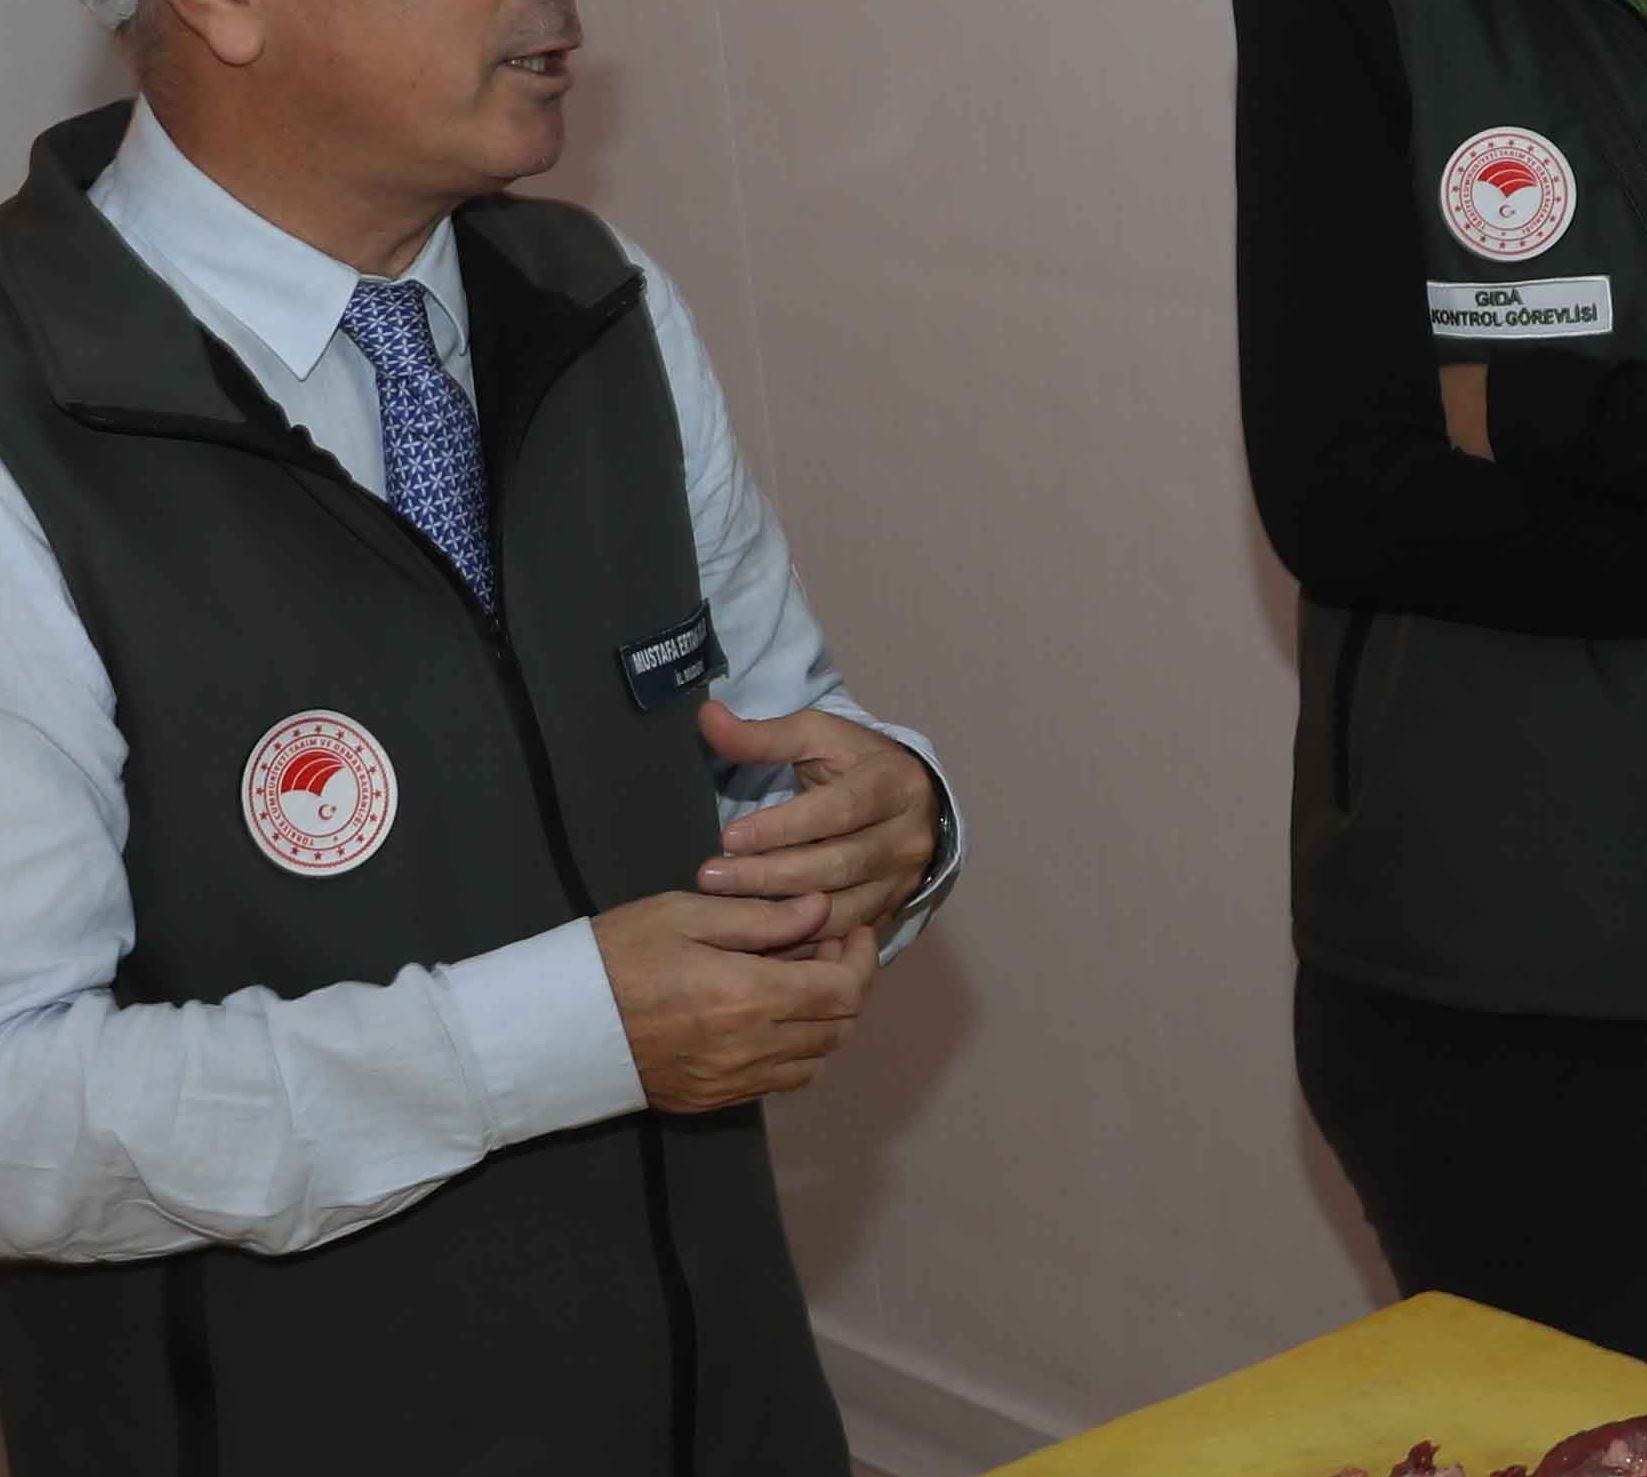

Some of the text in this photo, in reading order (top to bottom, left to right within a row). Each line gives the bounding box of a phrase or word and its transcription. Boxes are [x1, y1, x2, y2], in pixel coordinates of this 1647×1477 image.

[1475, 288, 1523, 307] GIDA
[1431, 302, 1598, 326] KONTROL GÖREVLİSİ
[632, 638, 680, 675] MUSTAFA
[289, 738, 318, 754] TARIM
[320, 738, 331, 748] VE
[334, 742, 363, 774] ORMAN
